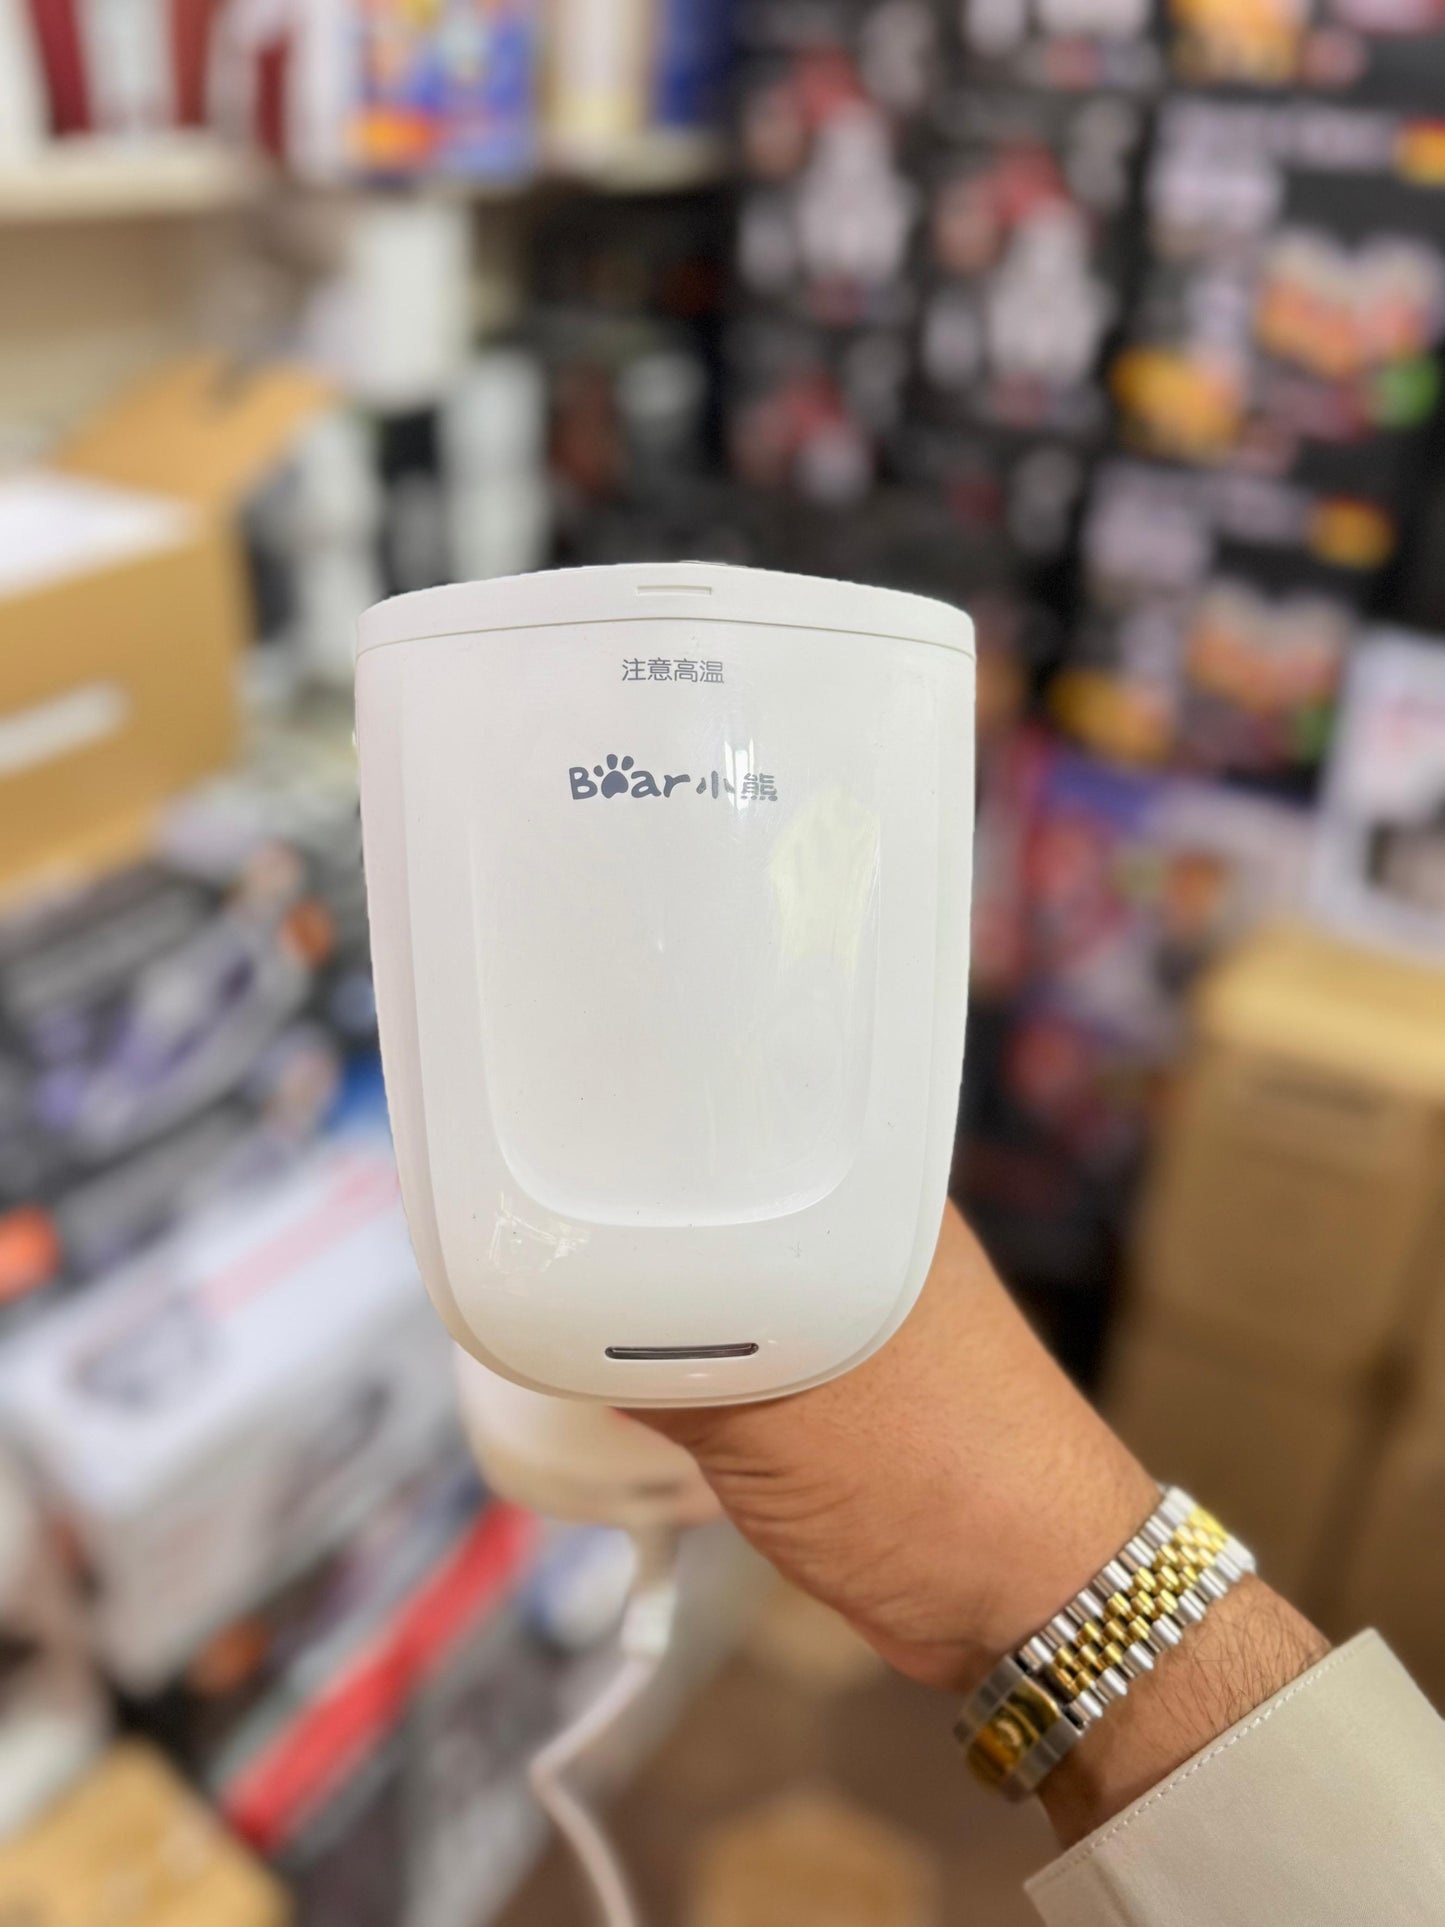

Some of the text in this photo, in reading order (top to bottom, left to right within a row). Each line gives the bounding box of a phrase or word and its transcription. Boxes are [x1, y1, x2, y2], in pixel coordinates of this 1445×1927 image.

[621, 657, 725, 684] 注意高温
[696, 770, 778, 801] 小熊
